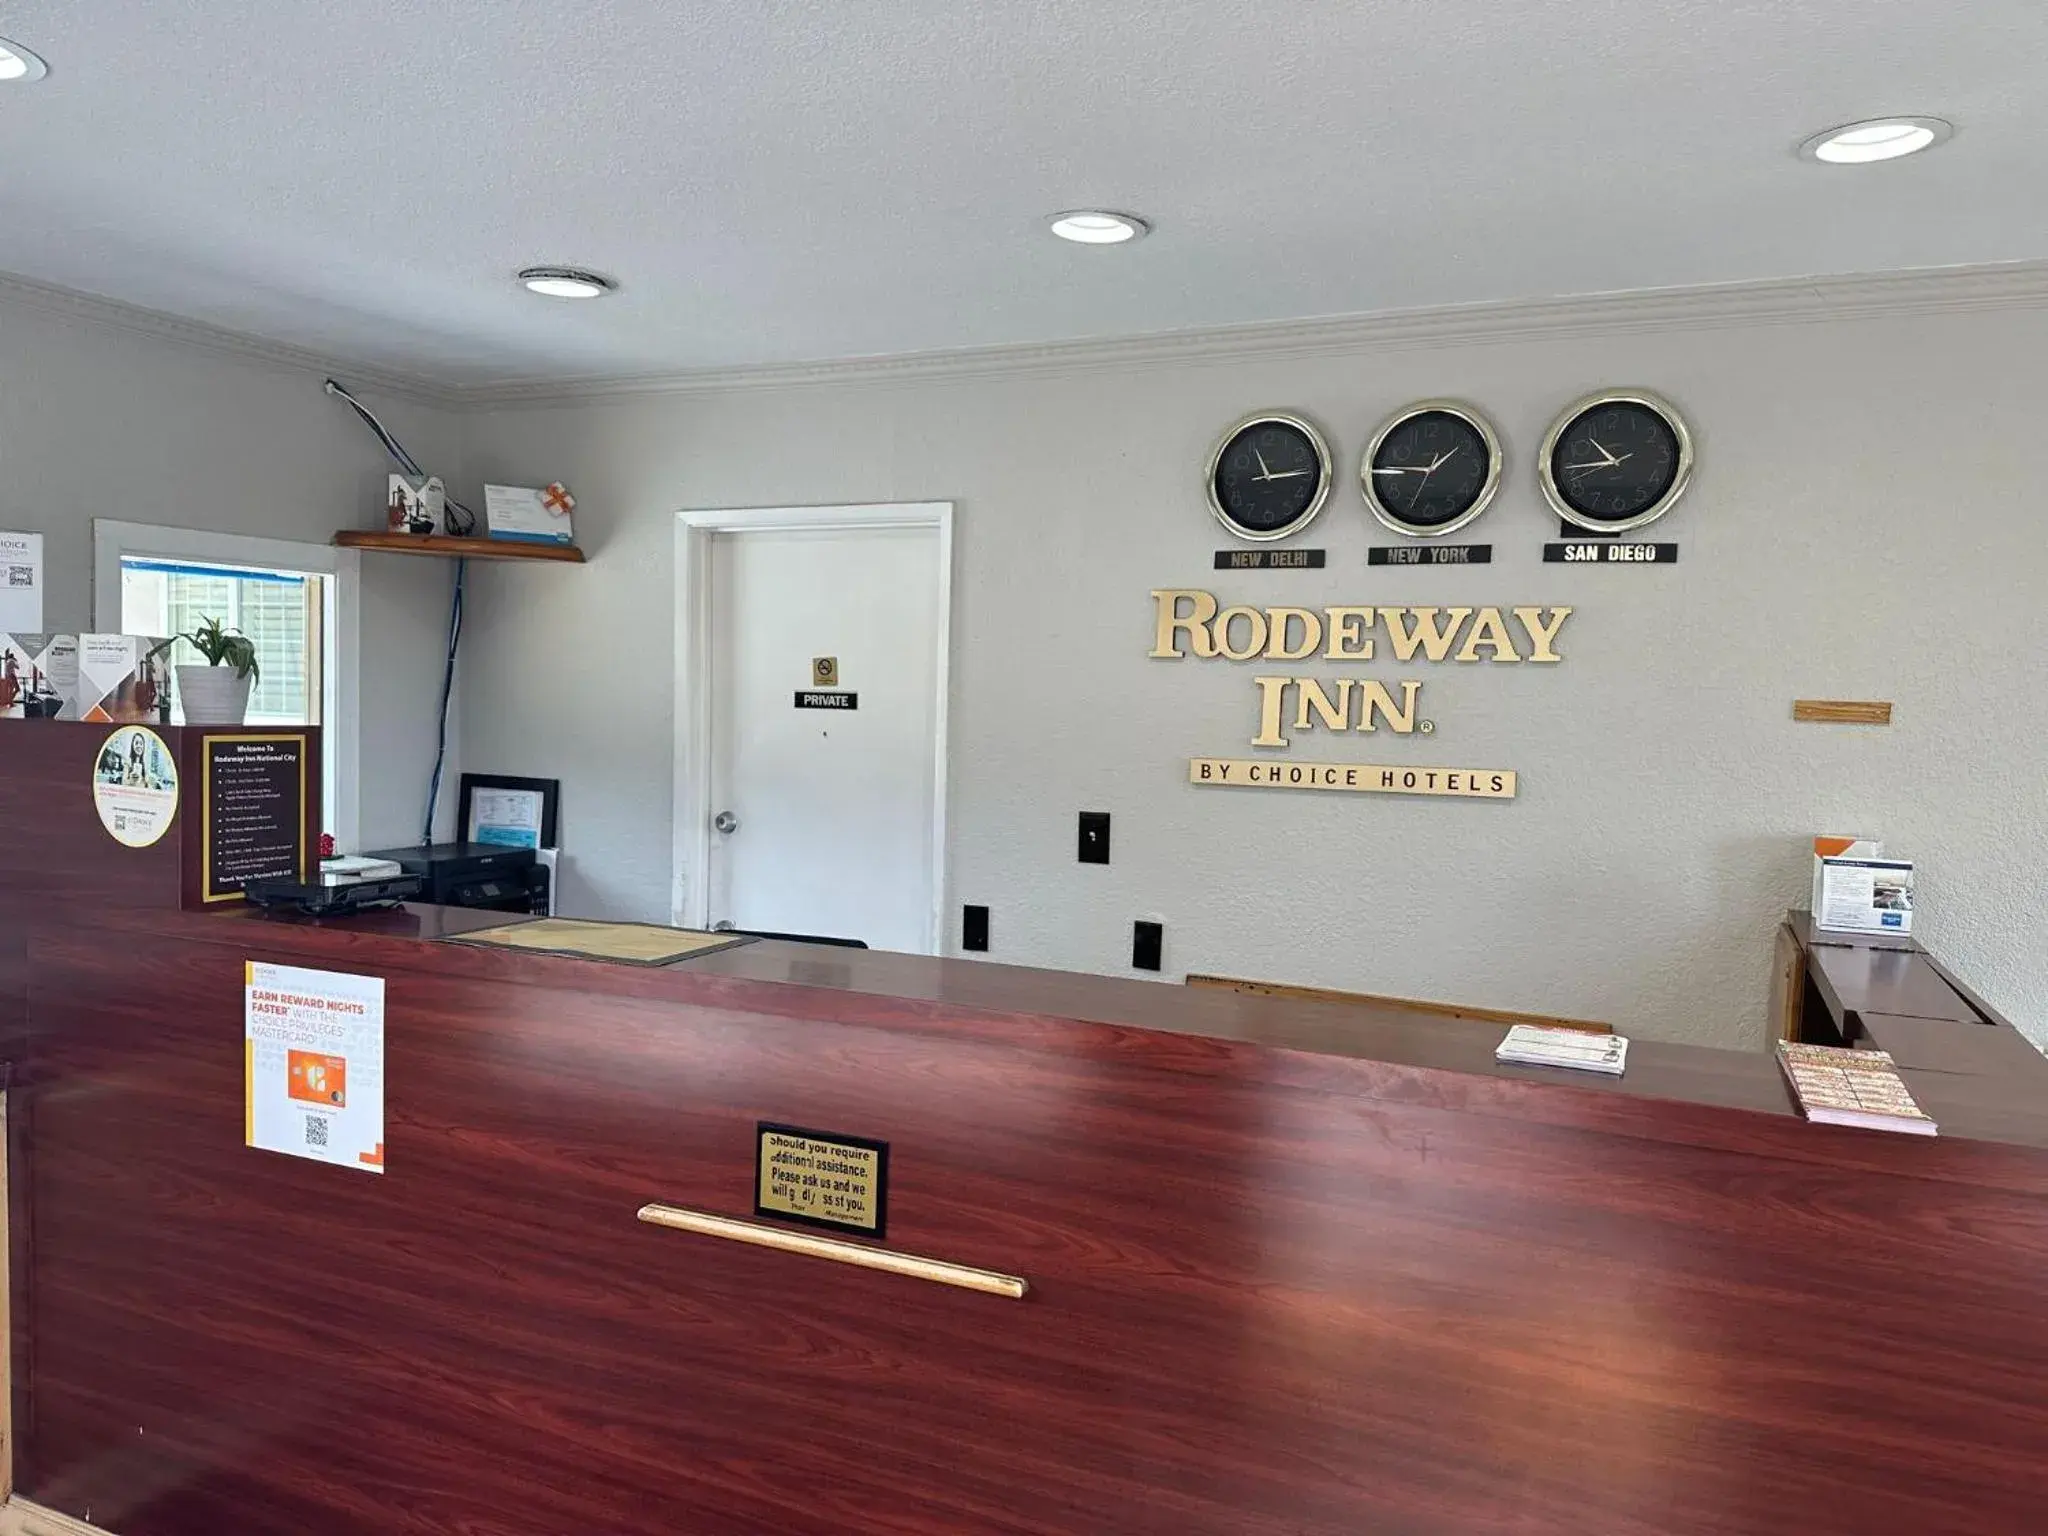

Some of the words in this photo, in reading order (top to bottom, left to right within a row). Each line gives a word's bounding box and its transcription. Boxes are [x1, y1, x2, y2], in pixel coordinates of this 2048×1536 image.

[1424, 422, 1439, 438] 12
[1231, 552, 1261, 567] NEW
[1270, 551, 1308, 566] DELHI
[1388, 548, 1423, 564] NEW
[1431, 547, 1470, 563] YORK
[1564, 545, 1598, 561] SAN
[1608, 545, 1656, 561] DIEGO
[1149, 588, 1572, 663] RODEWAY
[803, 694, 849, 707] PRIVATE
[1201, 763, 1231, 780] BY
[1250, 765, 1357, 786] CHOICE
[1382, 771, 1504, 792] HOTELS
[252, 989, 279, 1001] EARN
[281, 993, 325, 1009] REWARD
[327, 1000, 365, 1015] NIGHTS
[252, 1014, 288, 1029] CHOICE
[293, 1008, 317, 1020] WITH
[320, 1011, 339, 1022] THE
[770, 1135, 805, 1150] Should
[808, 1143, 828, 1155] you
[830, 1146, 870, 1161] require
[772, 1166, 801, 1184] Please
[802, 1173, 819, 1187] ask
[820, 1179, 831, 1189] us
[833, 1179, 850, 1192] and
[851, 1183, 866, 1195] we
[771, 1183, 788, 1197] will
[822, 1194, 845, 1208] ssst
